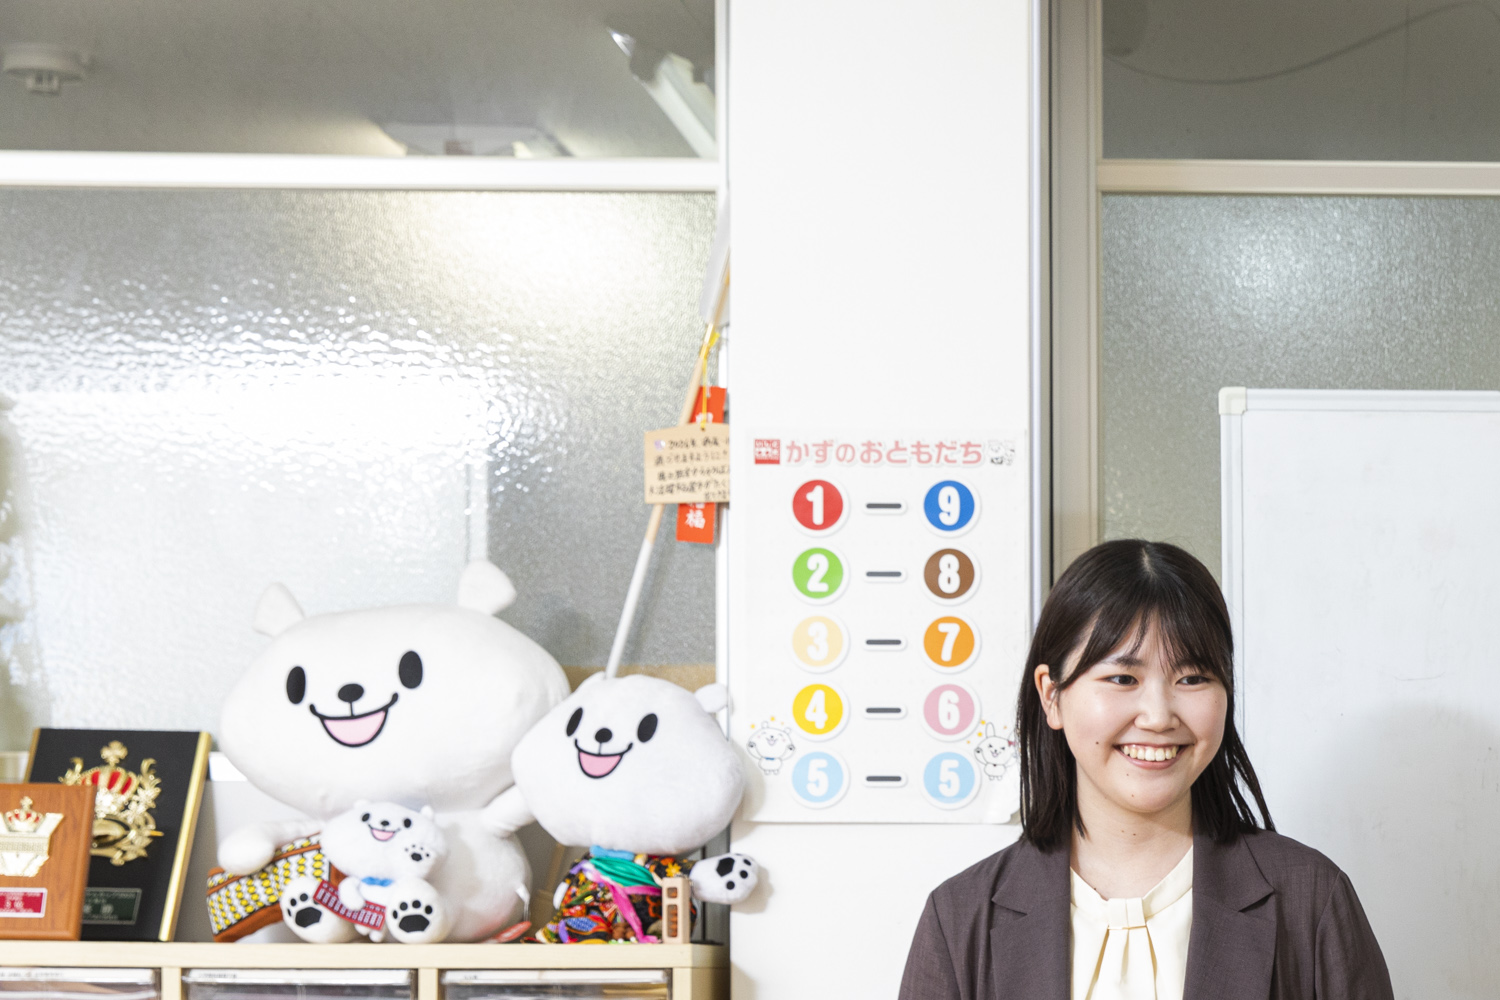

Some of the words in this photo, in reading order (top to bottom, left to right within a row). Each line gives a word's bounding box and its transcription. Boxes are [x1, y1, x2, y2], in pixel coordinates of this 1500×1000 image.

[786, 440, 982, 464] かずのおともだち
[805, 486, 824, 526] 1
[938, 486, 960, 526] 9
[806, 554, 829, 593] 2
[938, 554, 960, 593] 8
[807, 622, 829, 661] 3
[938, 622, 960, 662] 7
[805, 690, 829, 729] 4
[938, 690, 960, 729] 6
[807, 758, 829, 797] 5
[938, 758, 960, 797] 5
